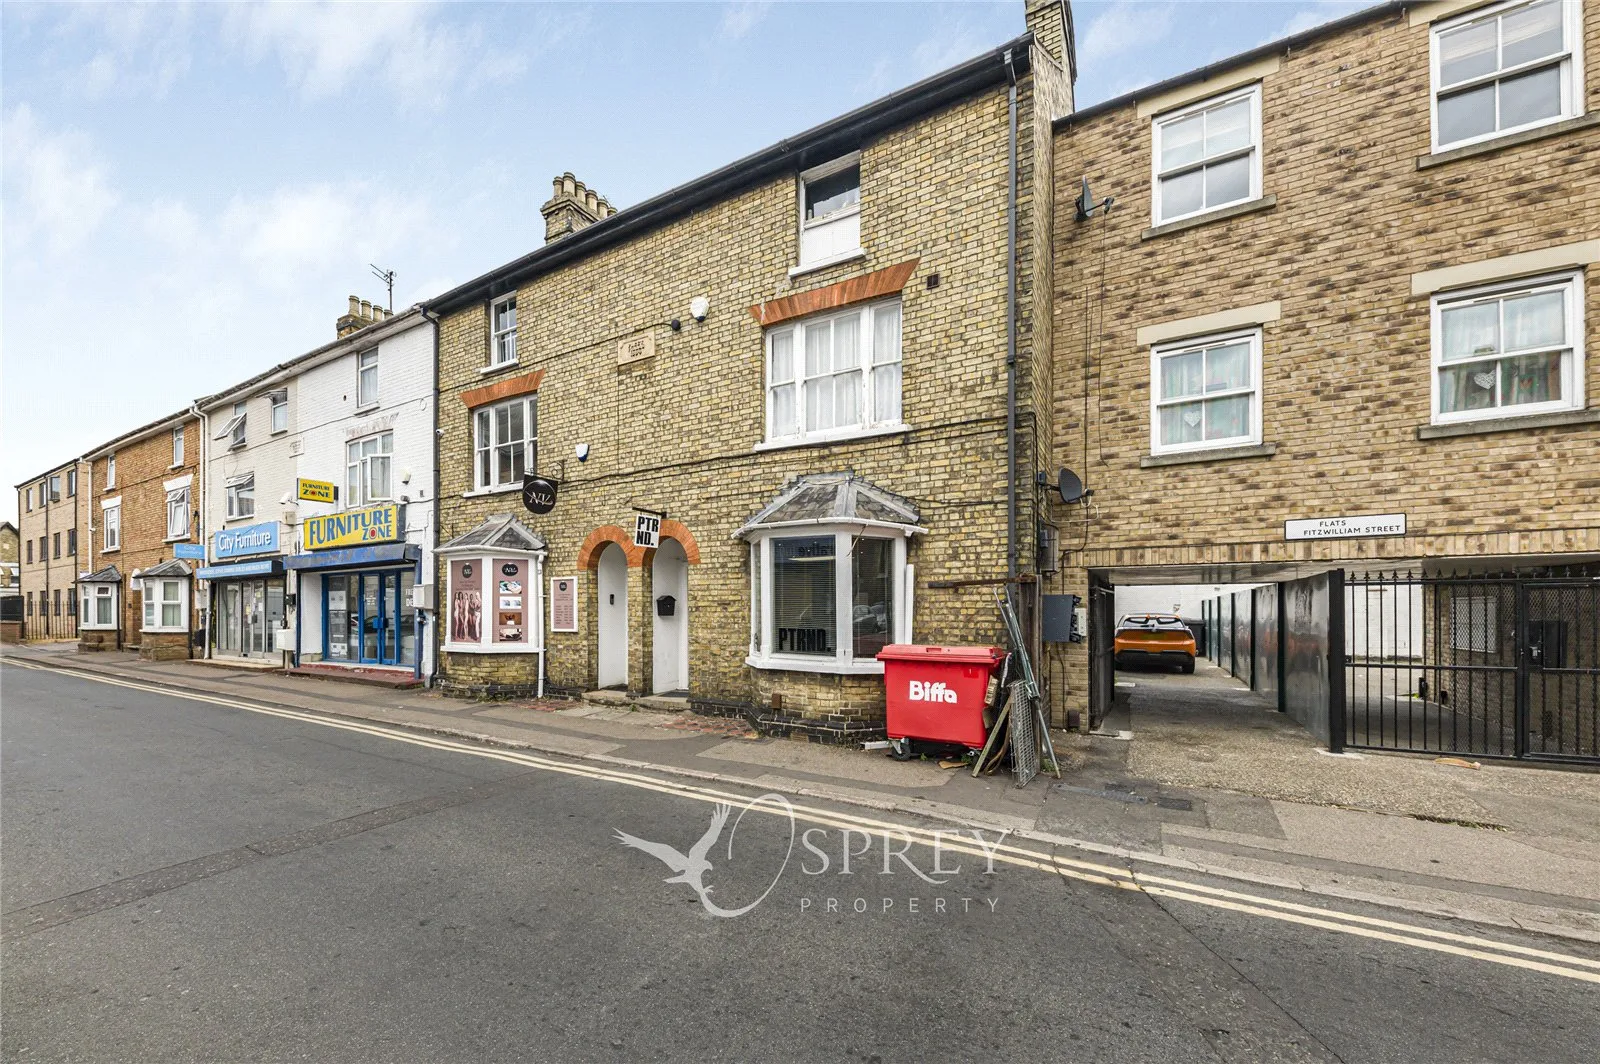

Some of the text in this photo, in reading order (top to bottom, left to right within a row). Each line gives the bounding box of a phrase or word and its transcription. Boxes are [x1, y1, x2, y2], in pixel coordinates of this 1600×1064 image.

[302, 482, 330, 491] FURNITURE
[302, 489, 330, 498] ZONE
[309, 508, 393, 546] FURNITURE
[362, 524, 392, 541] ZONE
[637, 515, 660, 533] PTR
[1303, 525, 1401, 536] FITZWILLIAM STREET
[218, 534, 235, 554] City
[235, 530, 272, 550] Furniture
[909, 680, 958, 704] Biffa
